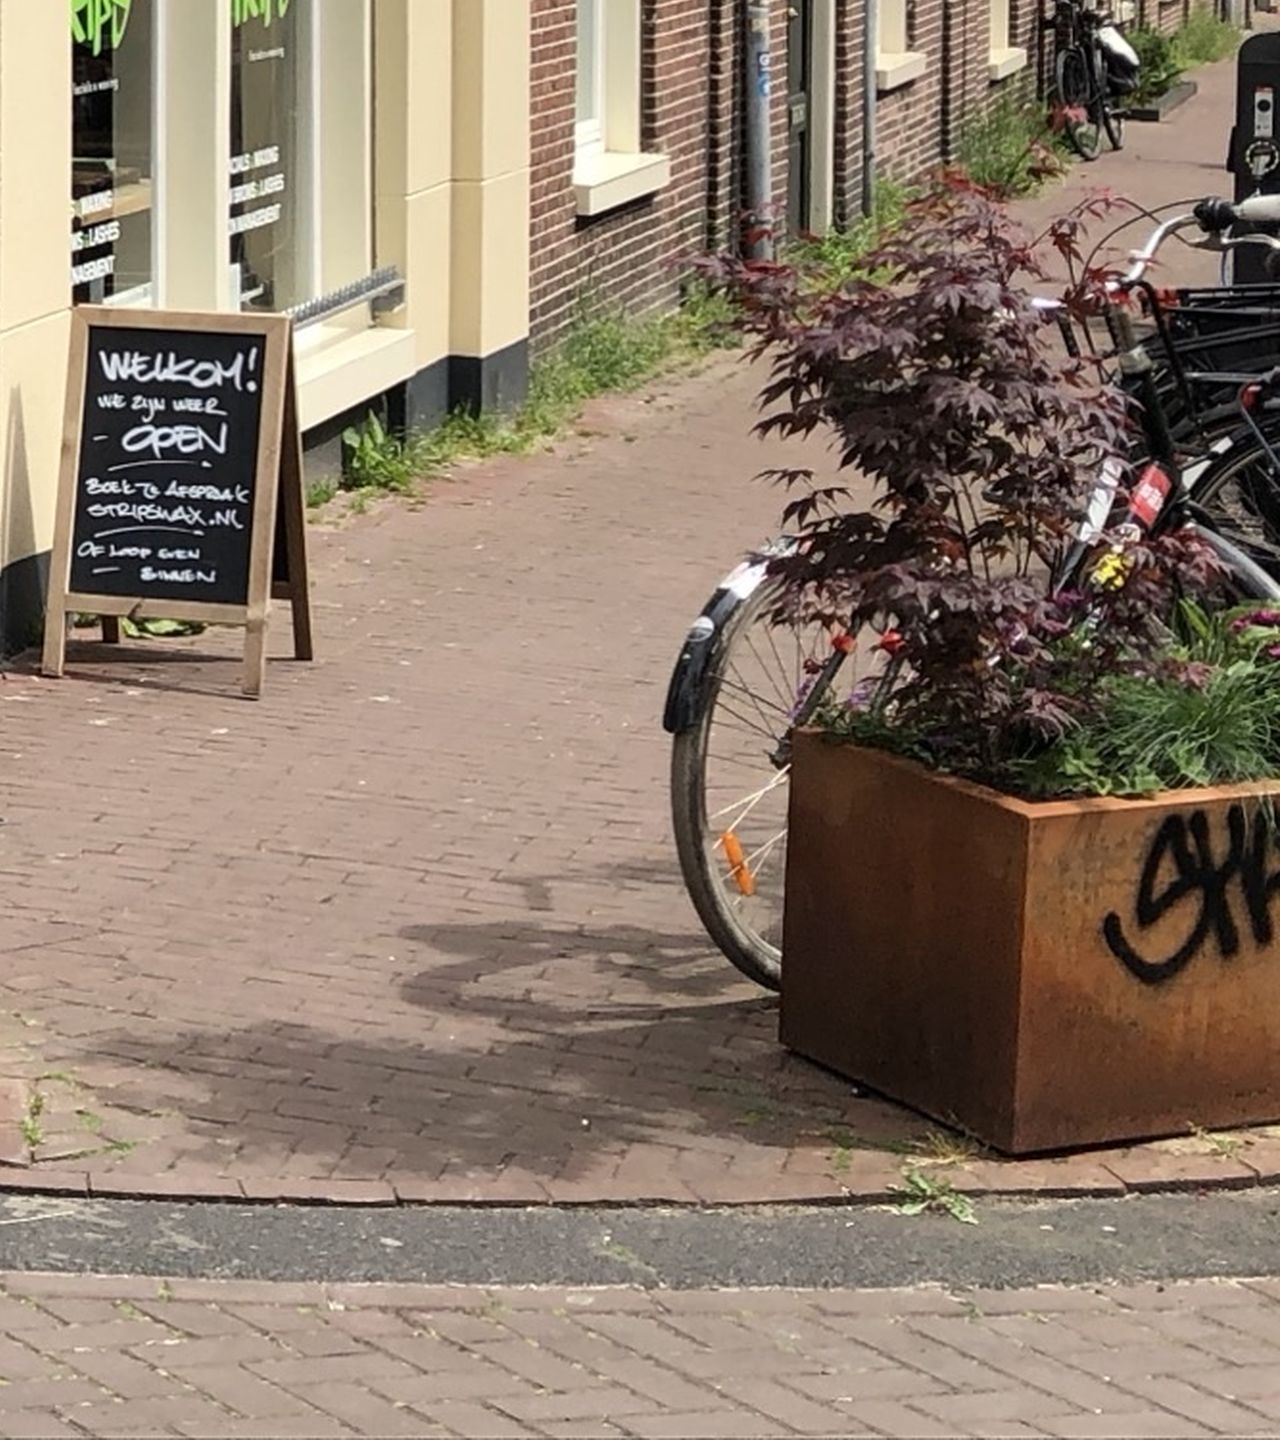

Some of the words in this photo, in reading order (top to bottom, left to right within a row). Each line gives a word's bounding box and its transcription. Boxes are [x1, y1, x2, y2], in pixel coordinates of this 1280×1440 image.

[99, 346, 258, 393] WELKOM!
[97, 393, 127, 409] WE
[131, 395, 166, 423] ZIJN
[172, 397, 228, 417] WEER
[121, 422, 228, 459] OPEN
[85, 477, 135, 495] BOEK
[77, 541, 106, 558] OF
[108, 544, 153, 559] LOOP
[157, 548, 200, 560] EVEN
[140, 566, 216, 583] BINNEN
